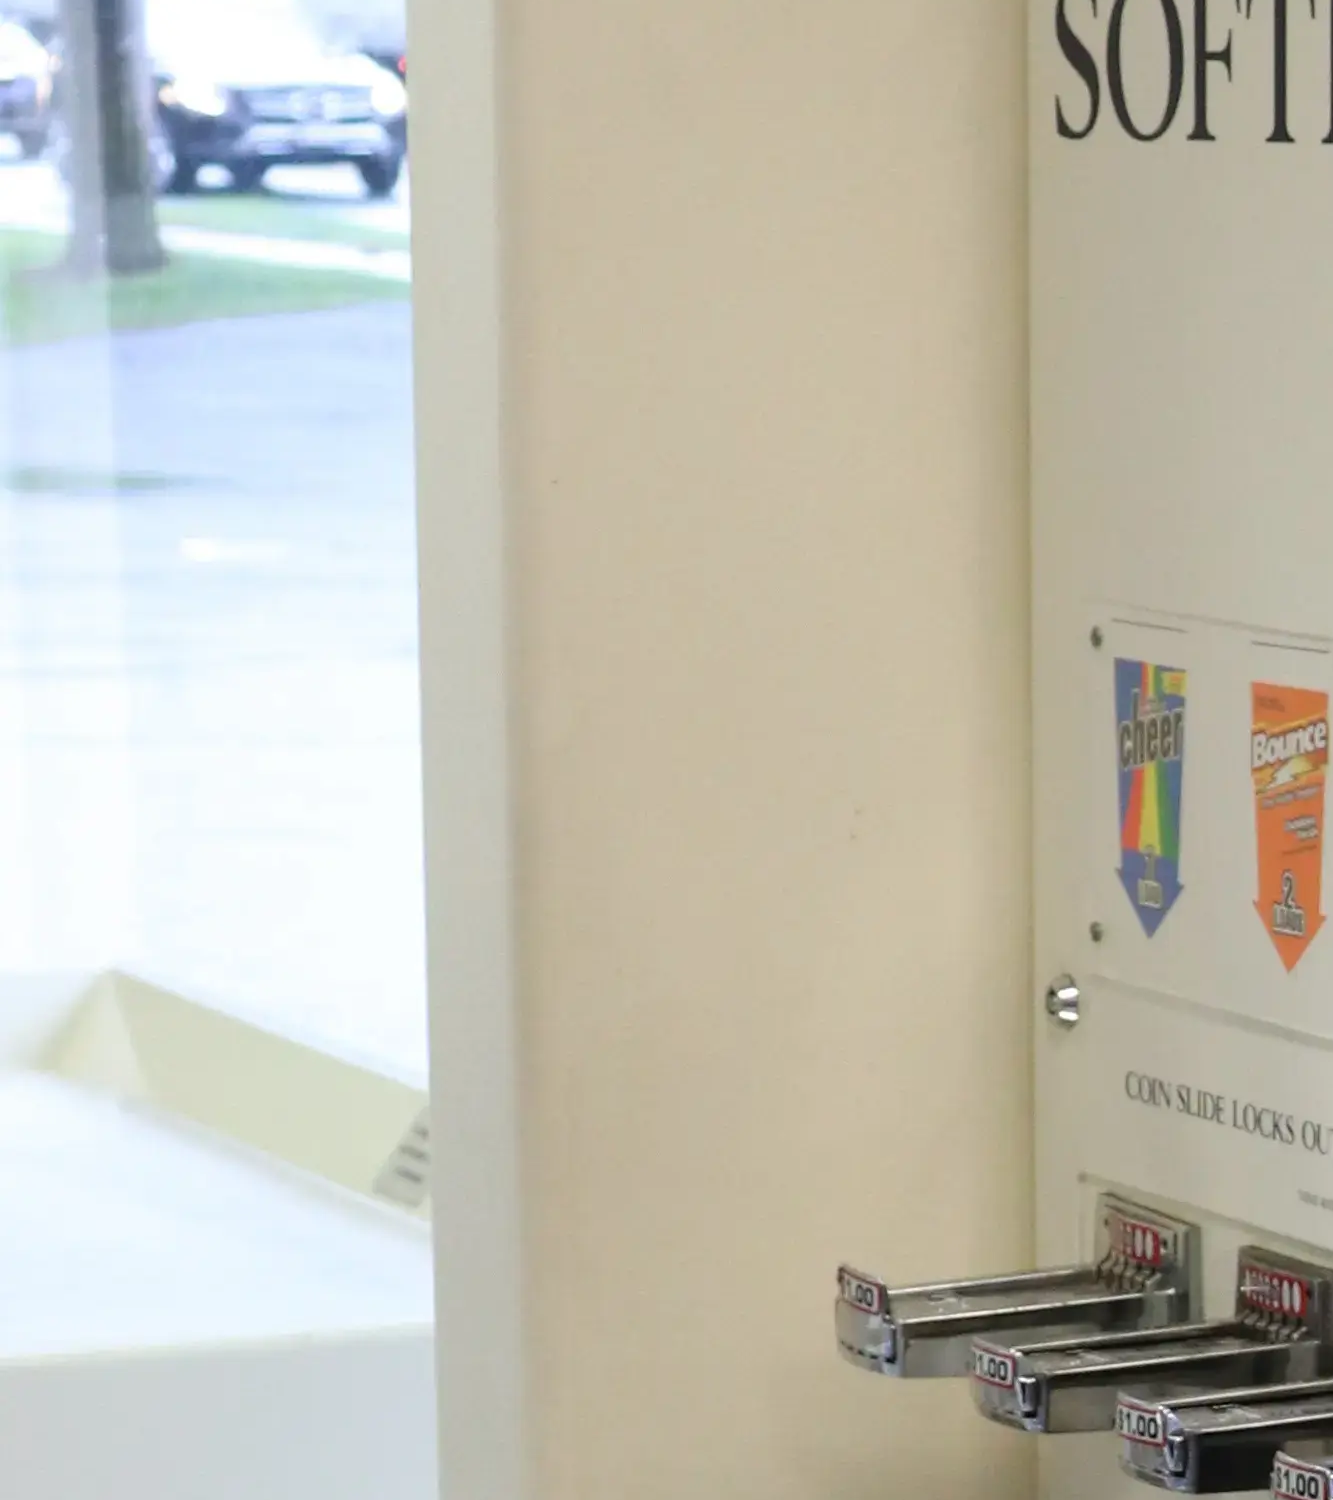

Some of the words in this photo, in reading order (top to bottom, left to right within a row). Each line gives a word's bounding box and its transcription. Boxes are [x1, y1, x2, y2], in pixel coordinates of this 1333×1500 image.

[1118, 686, 1186, 771] cheer
[1252, 720, 1328, 769] Bounce
[1124, 1070, 1172, 1106] COIN
[1176, 1085, 1226, 1124] SLIDE
[1232, 1099, 1295, 1146] LOCKS
